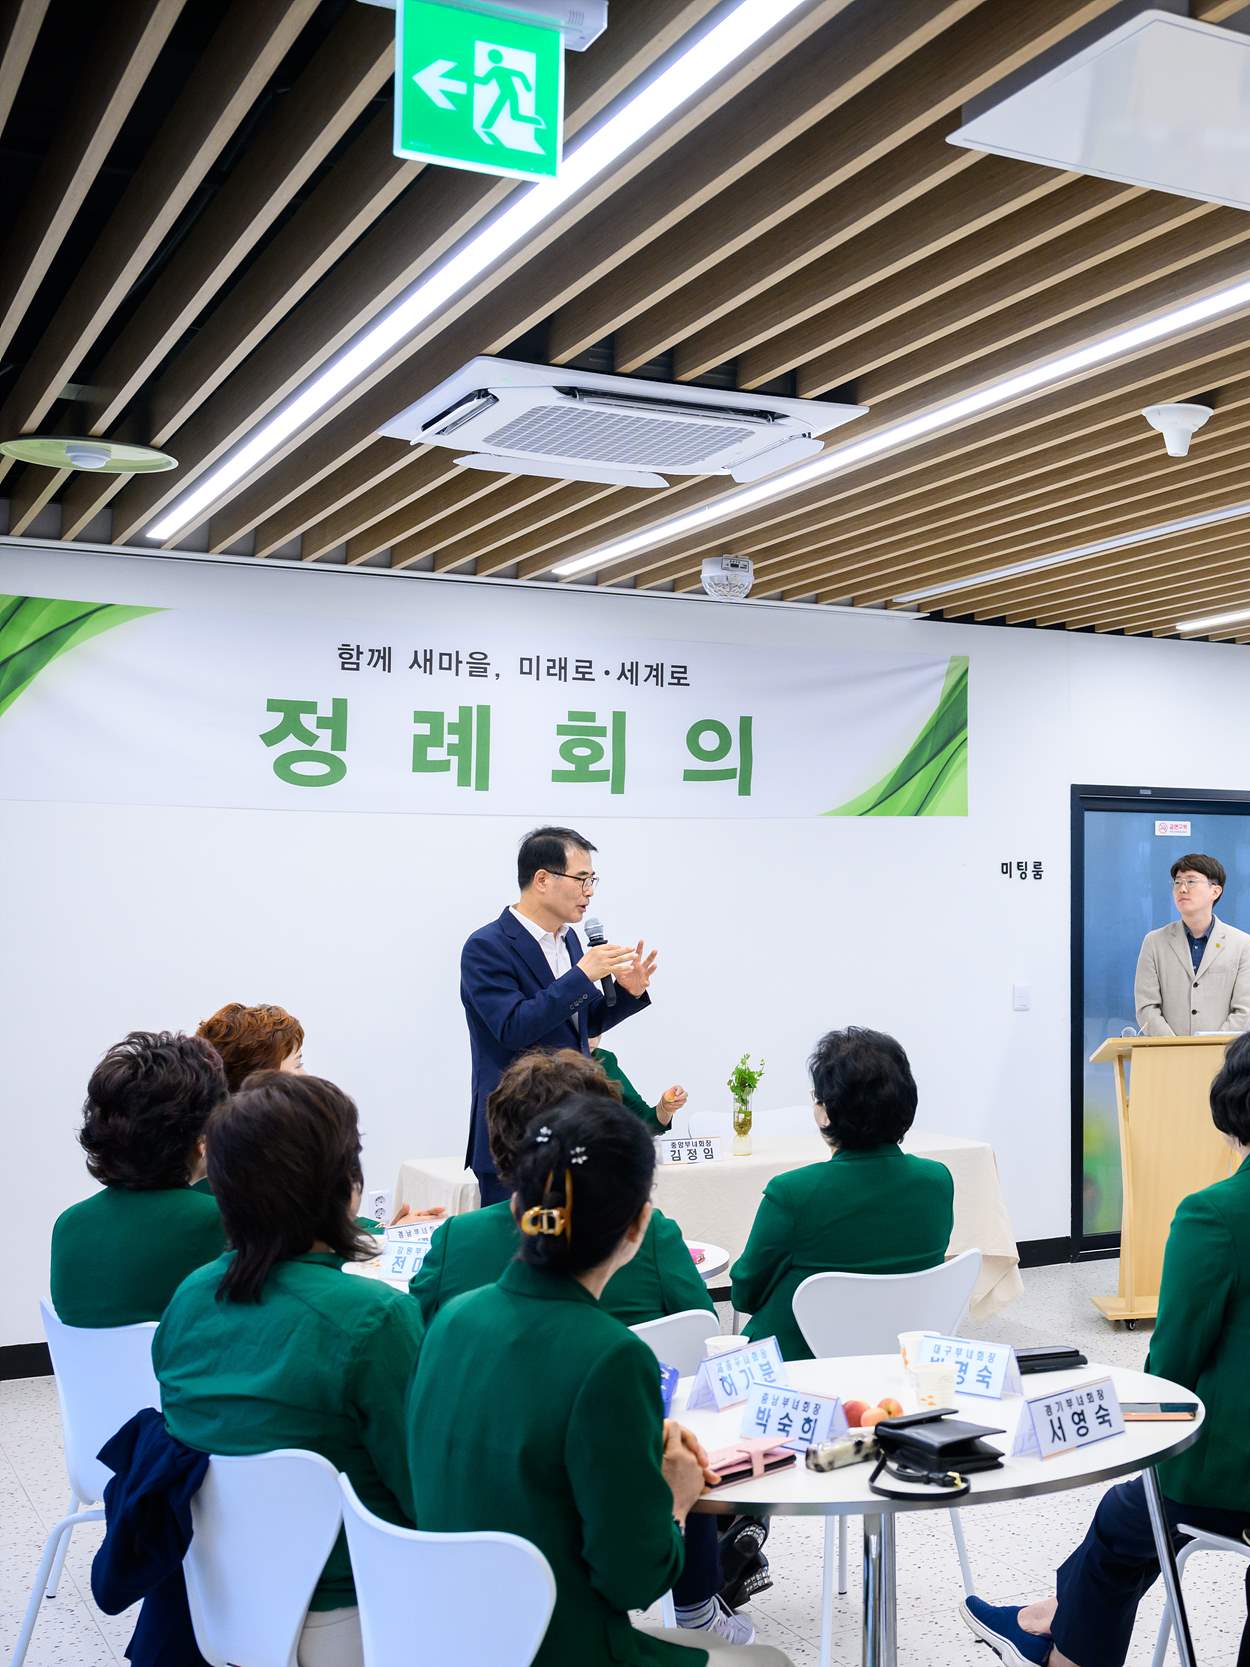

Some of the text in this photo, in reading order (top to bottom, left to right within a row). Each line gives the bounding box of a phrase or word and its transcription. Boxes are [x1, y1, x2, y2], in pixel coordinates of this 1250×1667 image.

[337, 643, 393, 674] 함께
[410, 648, 502, 681] 새마을,
[1001, 861, 1045, 881] 미팅룸
[670, 1148, 714, 1161] 김정임
[671, 1140, 711, 1148] 중앙부녀회장
[932, 1344, 997, 1364] 대구부녀회장
[760, 1392, 821, 1416] 충남부녀회장
[1044, 1389, 1105, 1417] 경기부녀회장
[754, 1406, 818, 1445] 박숙희
[1049, 1405, 1113, 1444] 서영숙
